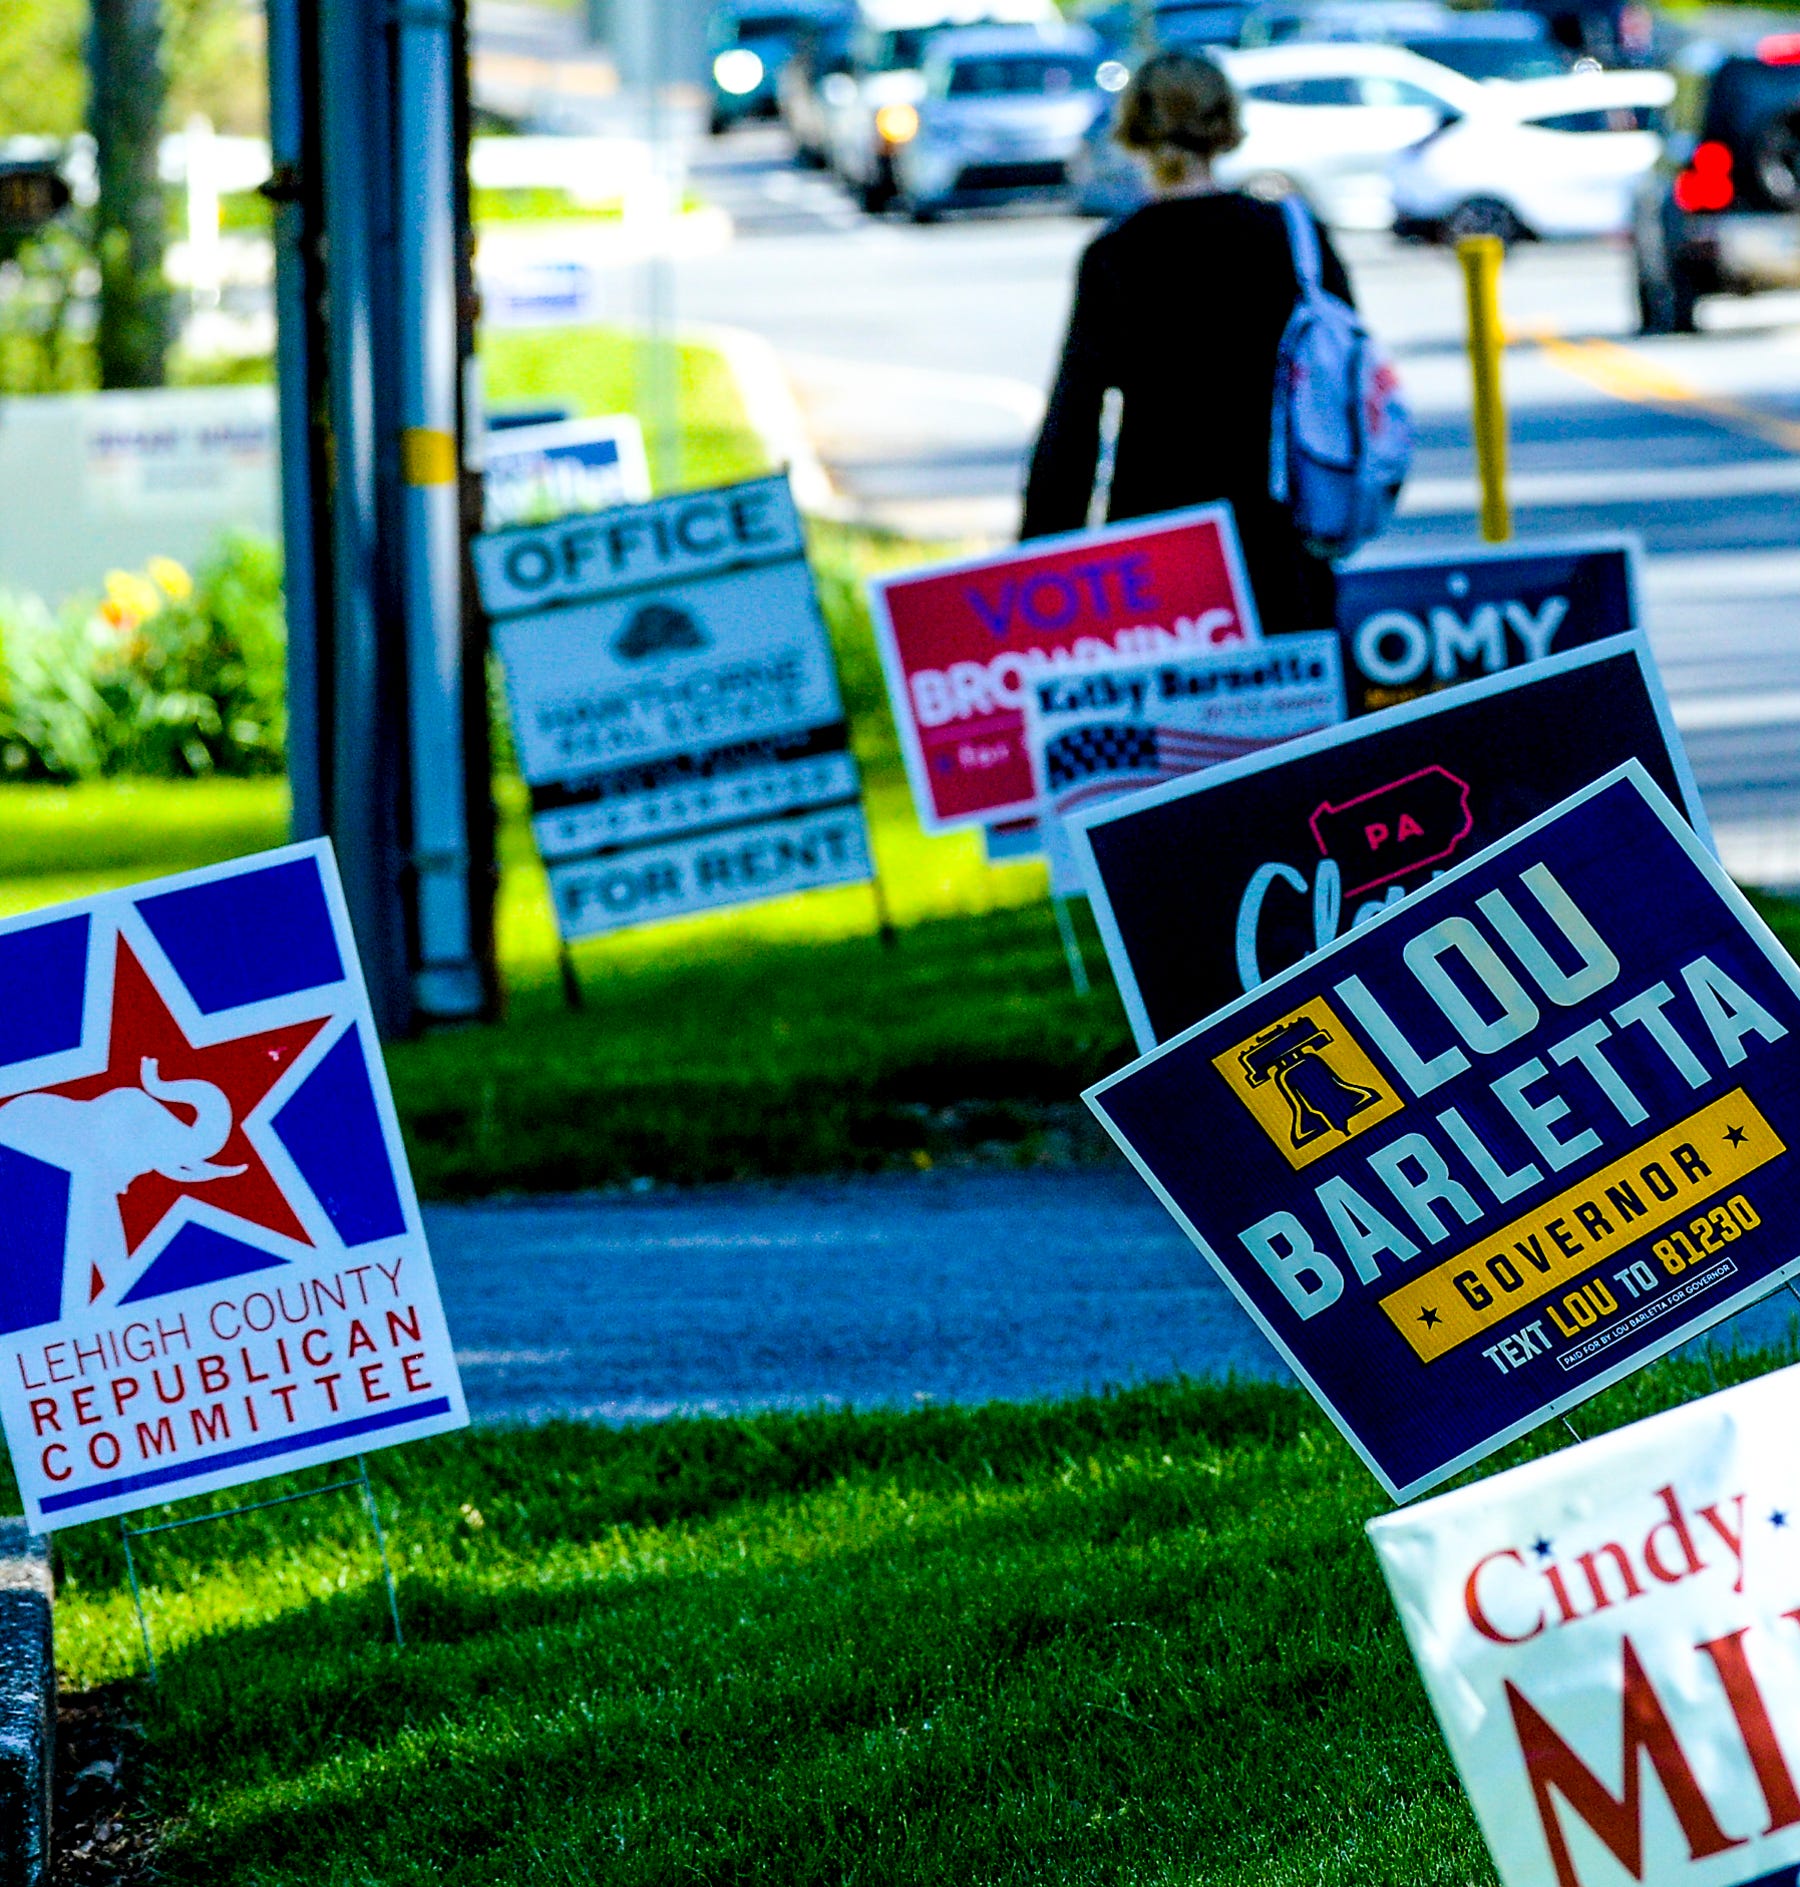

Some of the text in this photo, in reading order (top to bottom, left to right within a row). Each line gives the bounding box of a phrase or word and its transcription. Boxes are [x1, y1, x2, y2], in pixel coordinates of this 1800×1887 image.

[505, 490, 783, 592] OFFICE
[962, 552, 1160, 640] VOTE
[1354, 595, 1570, 685] OMY
[561, 858, 681, 922] FOR
[1364, 813, 1425, 850] PA
[1333, 862, 1622, 1099] LOU
[1237, 955, 1790, 1322] BARLETTA
[1455, 1141, 1713, 1314] GOVERNOR
[1482, 1194, 1763, 1376] TEXT LOU TO 81230
[15, 1257, 405, 1391] LEHIGH COUNTY
[30, 1305, 423, 1437] REPUBLICAN
[1564, 1263, 1731, 1366] PAID FOR BY LOU BARLETTA FOR GOVERNOR
[41, 1351, 433, 1483] COMMITTEE
[1463, 1479, 1748, 1647] Cindy
